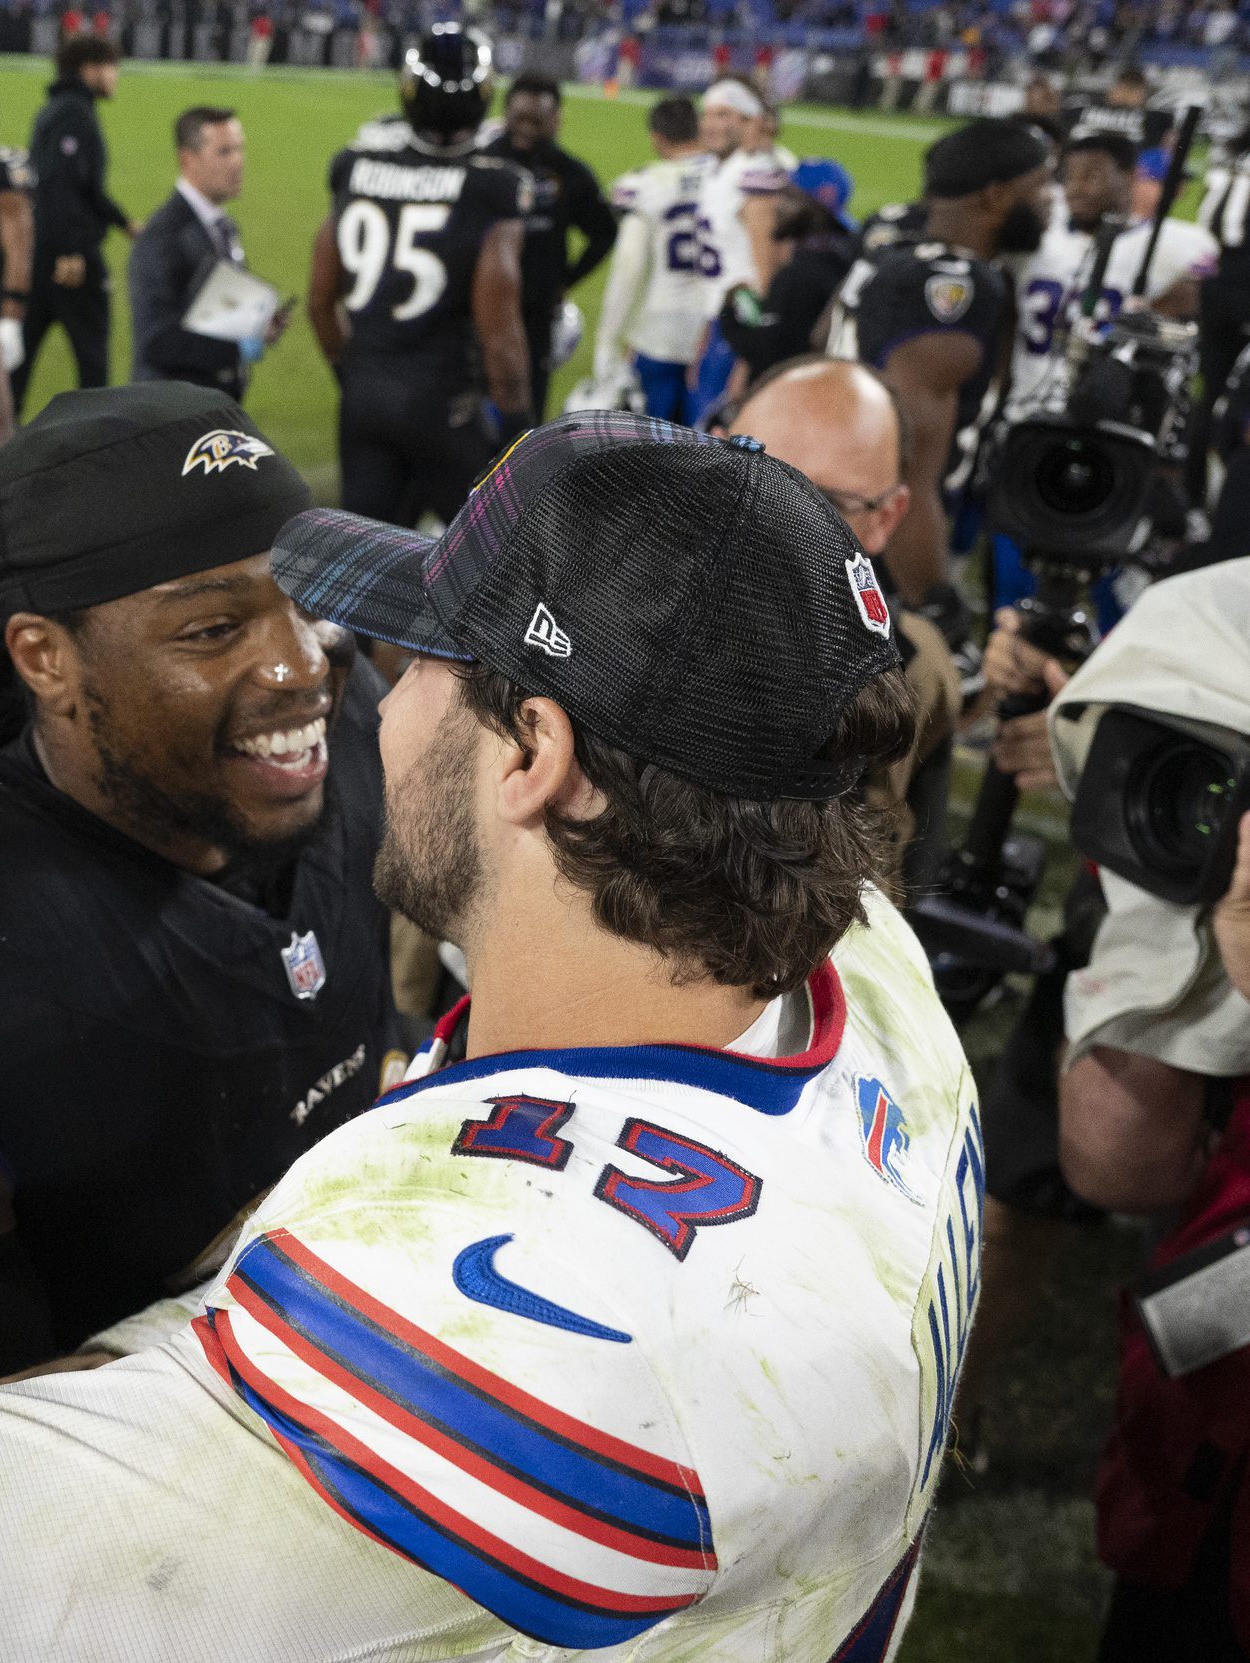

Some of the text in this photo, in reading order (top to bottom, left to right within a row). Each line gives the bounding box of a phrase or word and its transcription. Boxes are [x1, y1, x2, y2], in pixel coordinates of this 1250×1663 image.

[337, 199, 451, 321] 95
[290, 1043, 366, 1128] RAVENS
[451, 1094, 764, 1263] 17
